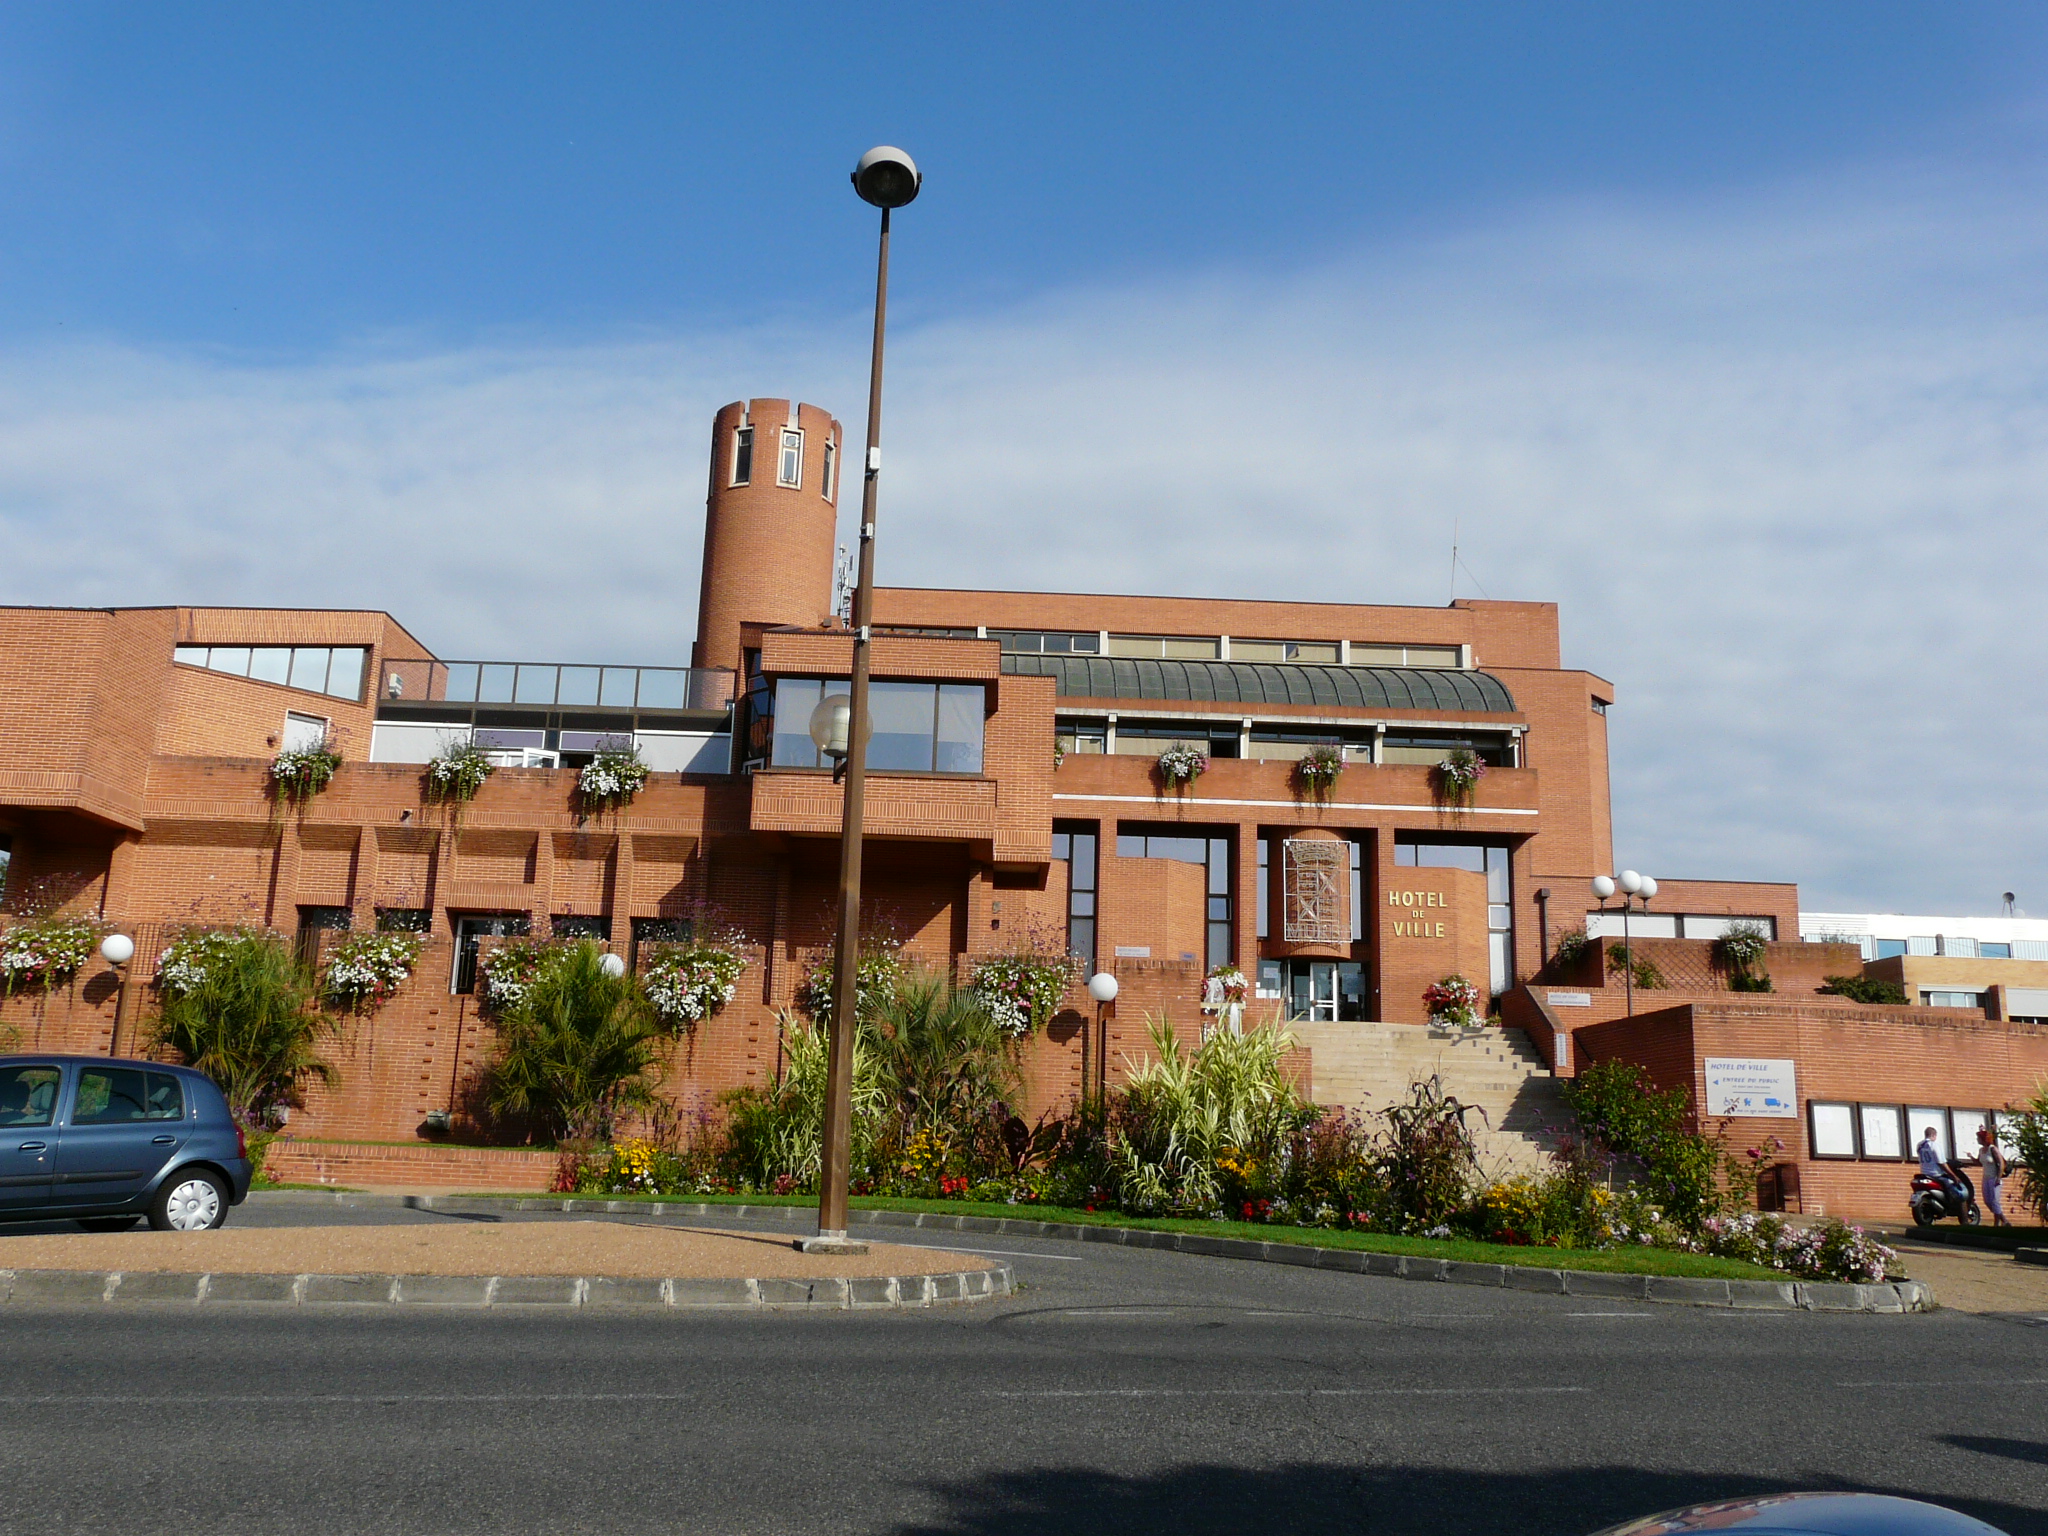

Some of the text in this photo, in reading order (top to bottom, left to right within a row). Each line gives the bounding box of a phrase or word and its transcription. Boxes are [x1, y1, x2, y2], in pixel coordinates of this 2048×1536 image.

[1389, 891, 1448, 907] HOTEL
[1412, 910, 1425, 918] DE
[1393, 921, 1445, 938] VILLE
